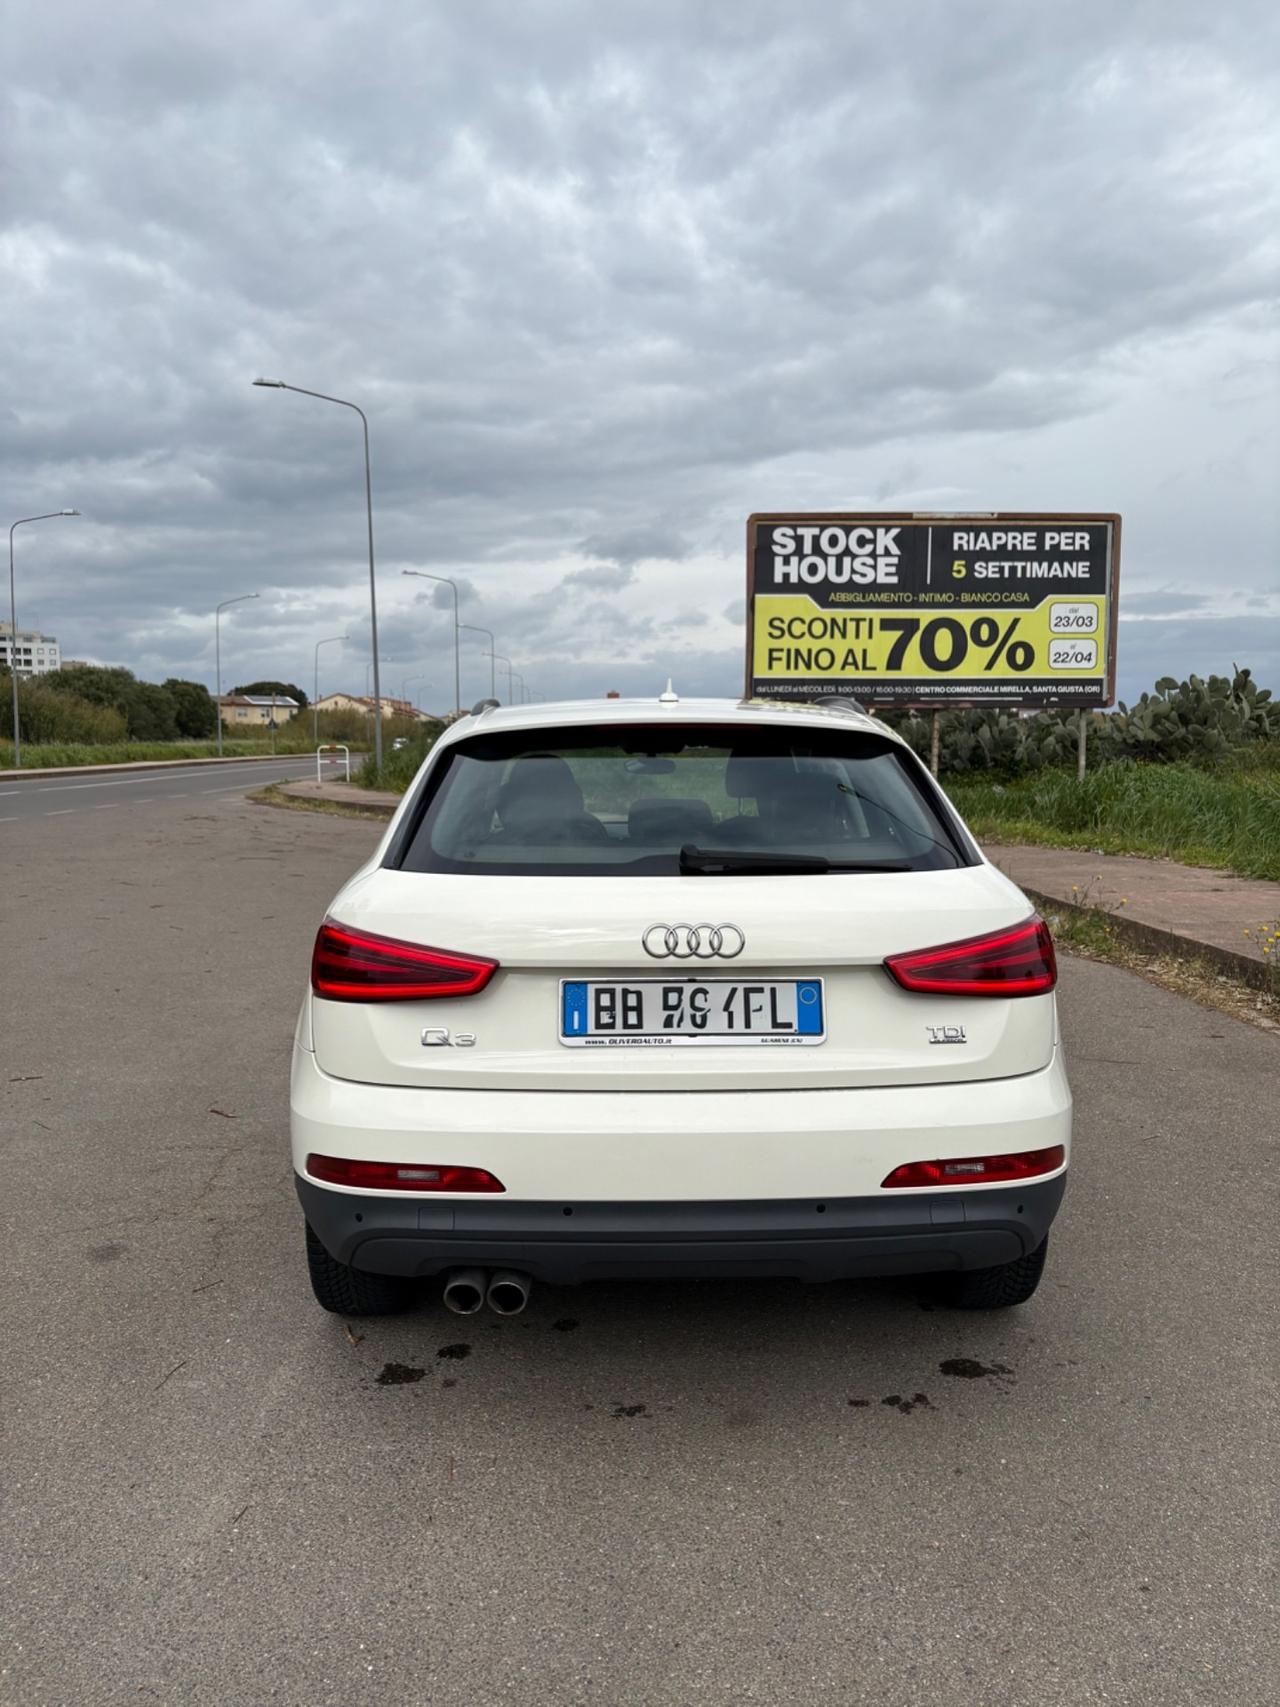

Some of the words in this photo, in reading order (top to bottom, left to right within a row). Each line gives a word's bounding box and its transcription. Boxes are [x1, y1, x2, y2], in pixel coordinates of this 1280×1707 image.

[771, 526, 902, 555] STOCK
[952, 531, 1037, 551] RIAPRE
[1044, 531, 1091, 551] PER
[773, 555, 899, 584] HOUSE
[952, 560, 967, 579] 5
[973, 561, 1091, 578] SETTIMANE
[828, 592, 913, 603] ABBIGLIAMENTO
[918, 592, 955, 603] INTIMO
[961, 592, 1002, 603] BIANCO
[1003, 592, 1030, 602] CASA
[767, 616, 874, 640] SCONTI
[1053, 615, 1094, 628] 23/03
[879, 616, 1036, 672] 70%
[767, 647, 836, 671] FINO
[839, 648, 877, 671] AL
[1052, 651, 1093, 664] 22/04
[915, 686, 946, 694] CENTRO
[946, 686, 1000, 694] COMMERCIALE
[1000, 686, 1032, 695] MIRELLA,
[1032, 686, 1057, 694] SANTA
[1057, 686, 1084, 694] GIUSTA
[420, 1026, 477, 1048] Q3
[925, 1024, 966, 1039] TDI
